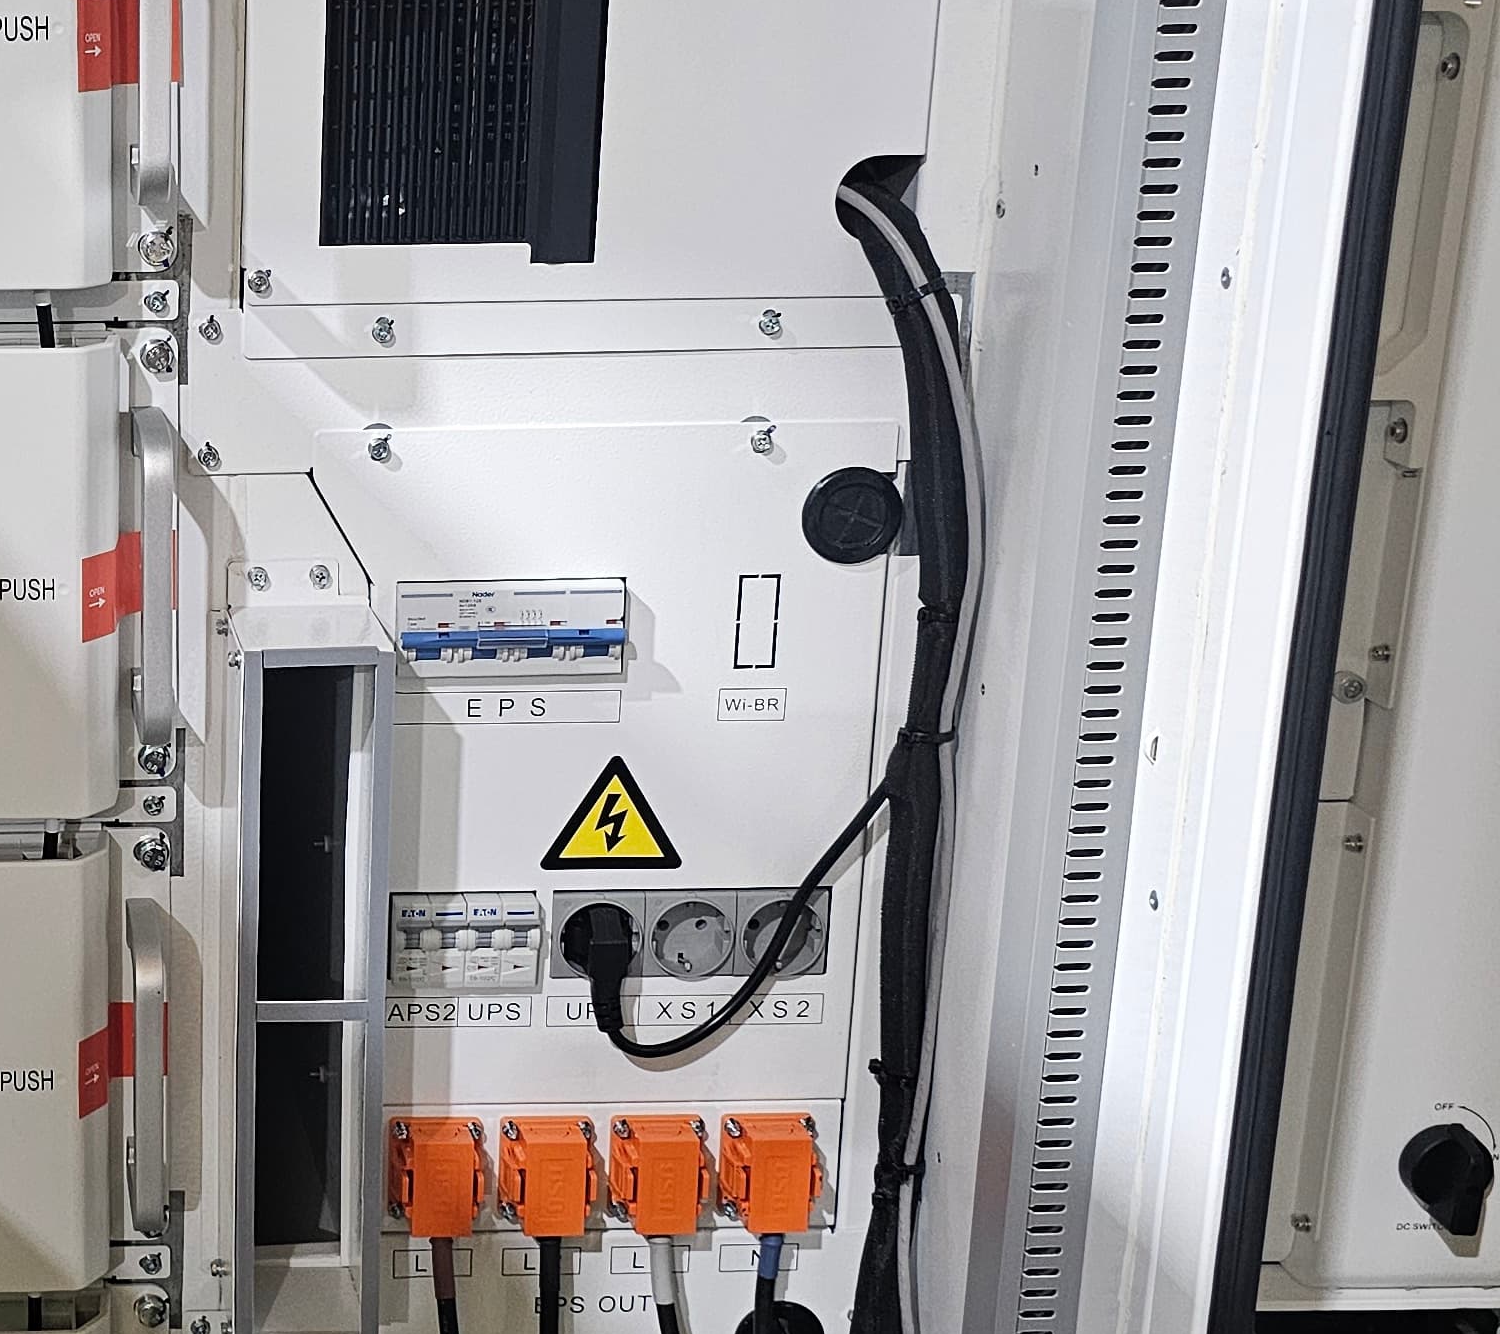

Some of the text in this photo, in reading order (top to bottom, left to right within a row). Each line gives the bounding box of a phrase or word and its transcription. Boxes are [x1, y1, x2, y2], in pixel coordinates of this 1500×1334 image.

[84, 33, 101, 43] OPEN
[0, 578, 56, 601] PUSH
[88, 586, 106, 598] OPEN
[725, 698, 779, 712] Wi-BR
[387, 1003, 456, 1022] APS2
[468, 1003, 521, 1021] UPS
[566, 1002, 595, 1021] UP
[0, 1069, 54, 1092] PUSH
[1434, 1102, 1455, 1111] OFF
[1396, 1222, 1444, 1231] DC SWITC
[415, 1254, 428, 1272] L
[524, 1253, 536, 1271] L
[632, 1251, 645, 1269] L
[598, 1295, 653, 1313] OUT
